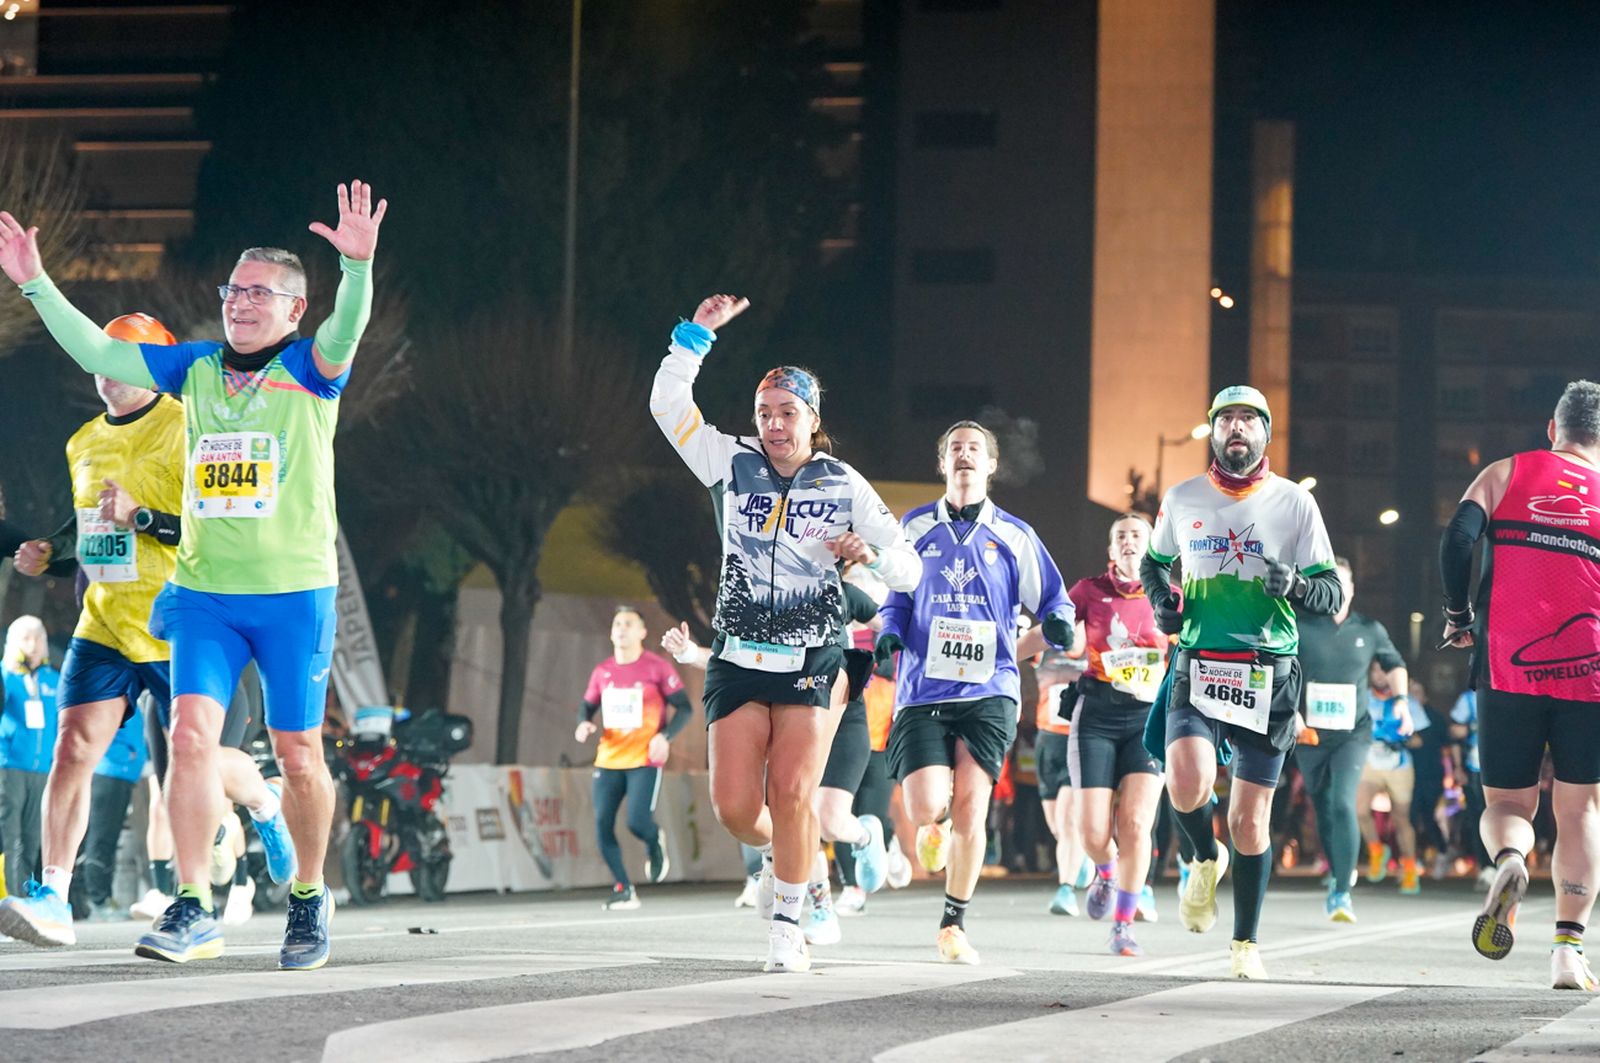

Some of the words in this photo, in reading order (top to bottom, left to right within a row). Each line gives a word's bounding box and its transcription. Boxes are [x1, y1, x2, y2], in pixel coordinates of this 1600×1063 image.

[200, 452, 215, 463] SAN
[204, 463, 258, 489] 3844
[1530, 513, 1589, 527] MANCHATHON
[954, 594, 987, 606] RURAL
[937, 631, 951, 640] SAN
[941, 640, 985, 662] 4448
[1199, 675, 1215, 684] SAN
[1209, 668, 1233, 679] NOCHE
[1233, 671, 1243, 679] DE
[1204, 683, 1257, 710] 4685
